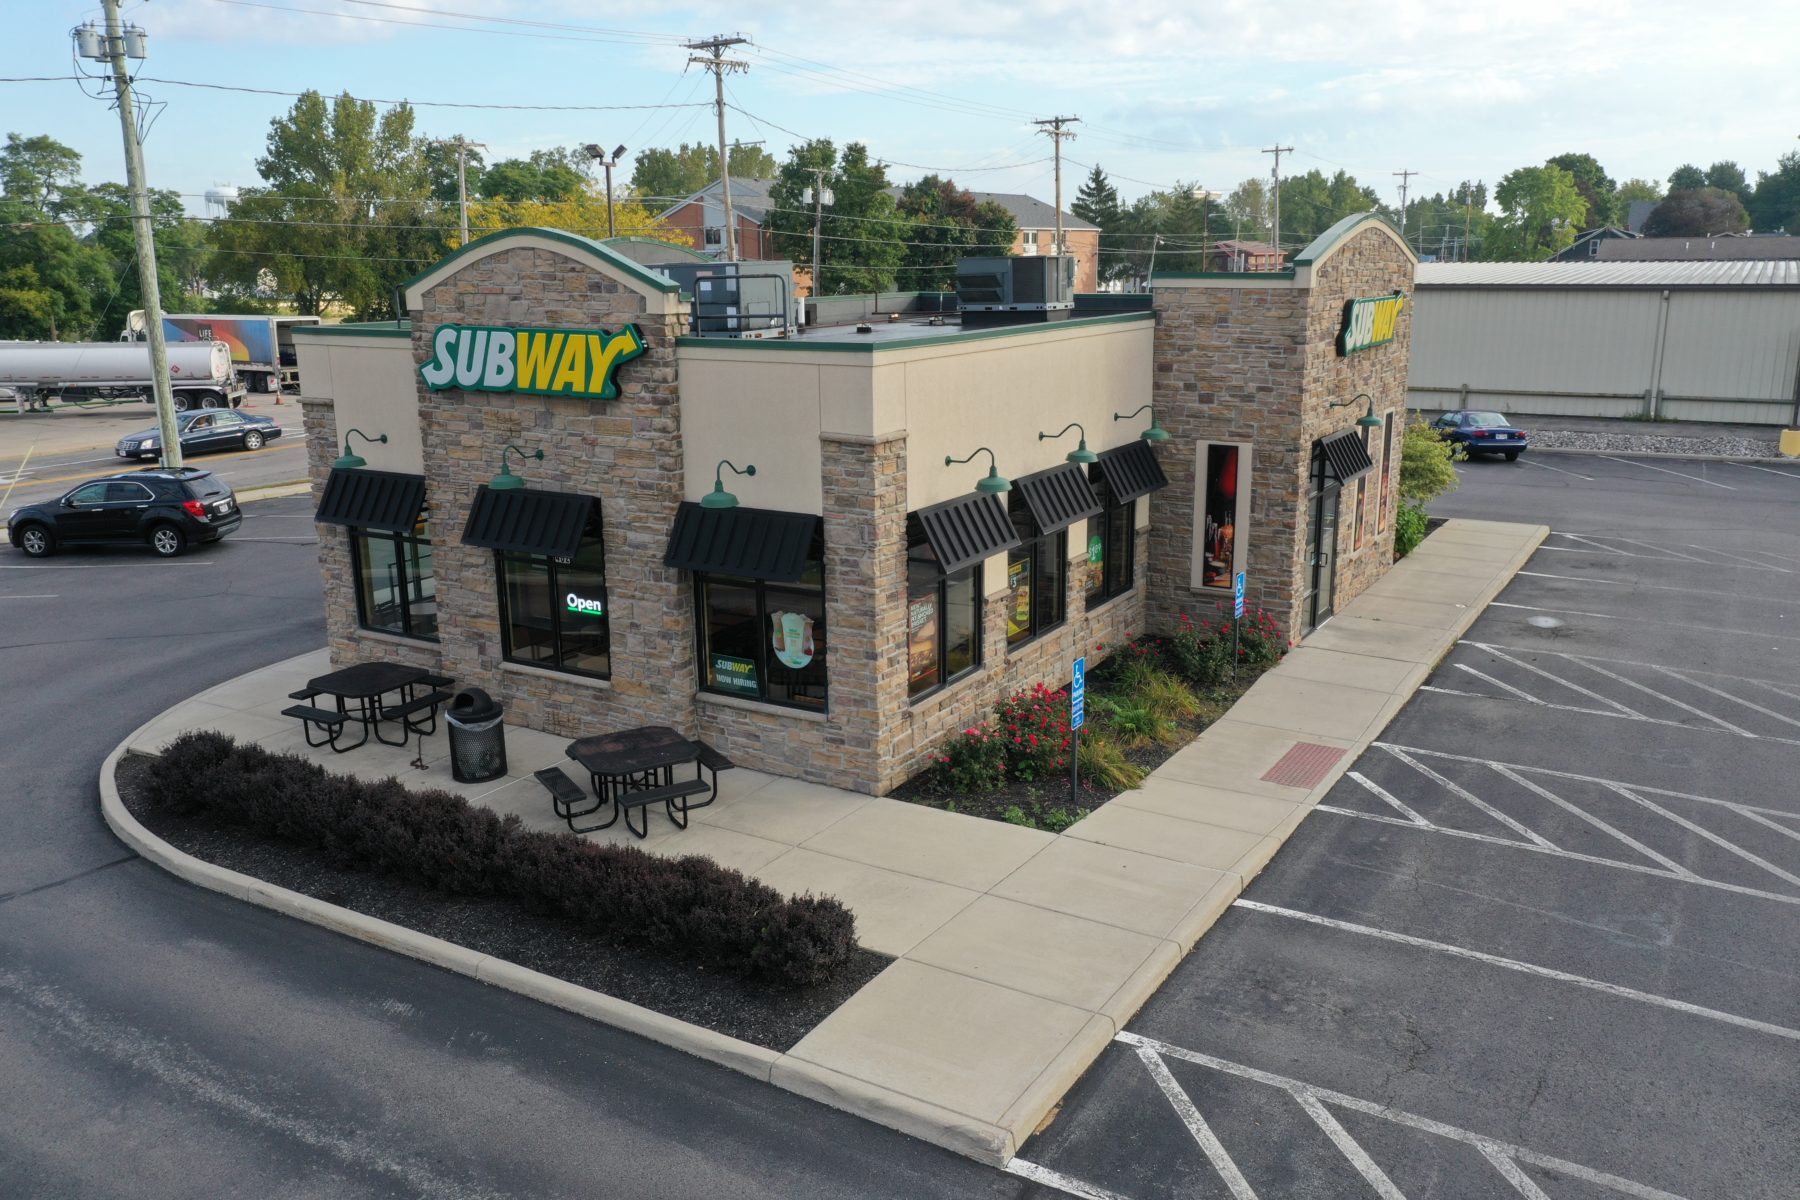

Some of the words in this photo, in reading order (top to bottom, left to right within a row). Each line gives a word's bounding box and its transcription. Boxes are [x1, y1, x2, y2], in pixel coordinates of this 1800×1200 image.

[1346, 296, 1404, 352] SUBWAY
[199, 329, 212, 338] LIFE
[421, 328, 638, 394] SUBWAY
[566, 593, 602, 612] Open
[715, 659, 754, 674] SUBWAY
[716, 674, 732, 684] NOW
[733, 677, 758, 689] HIRING
